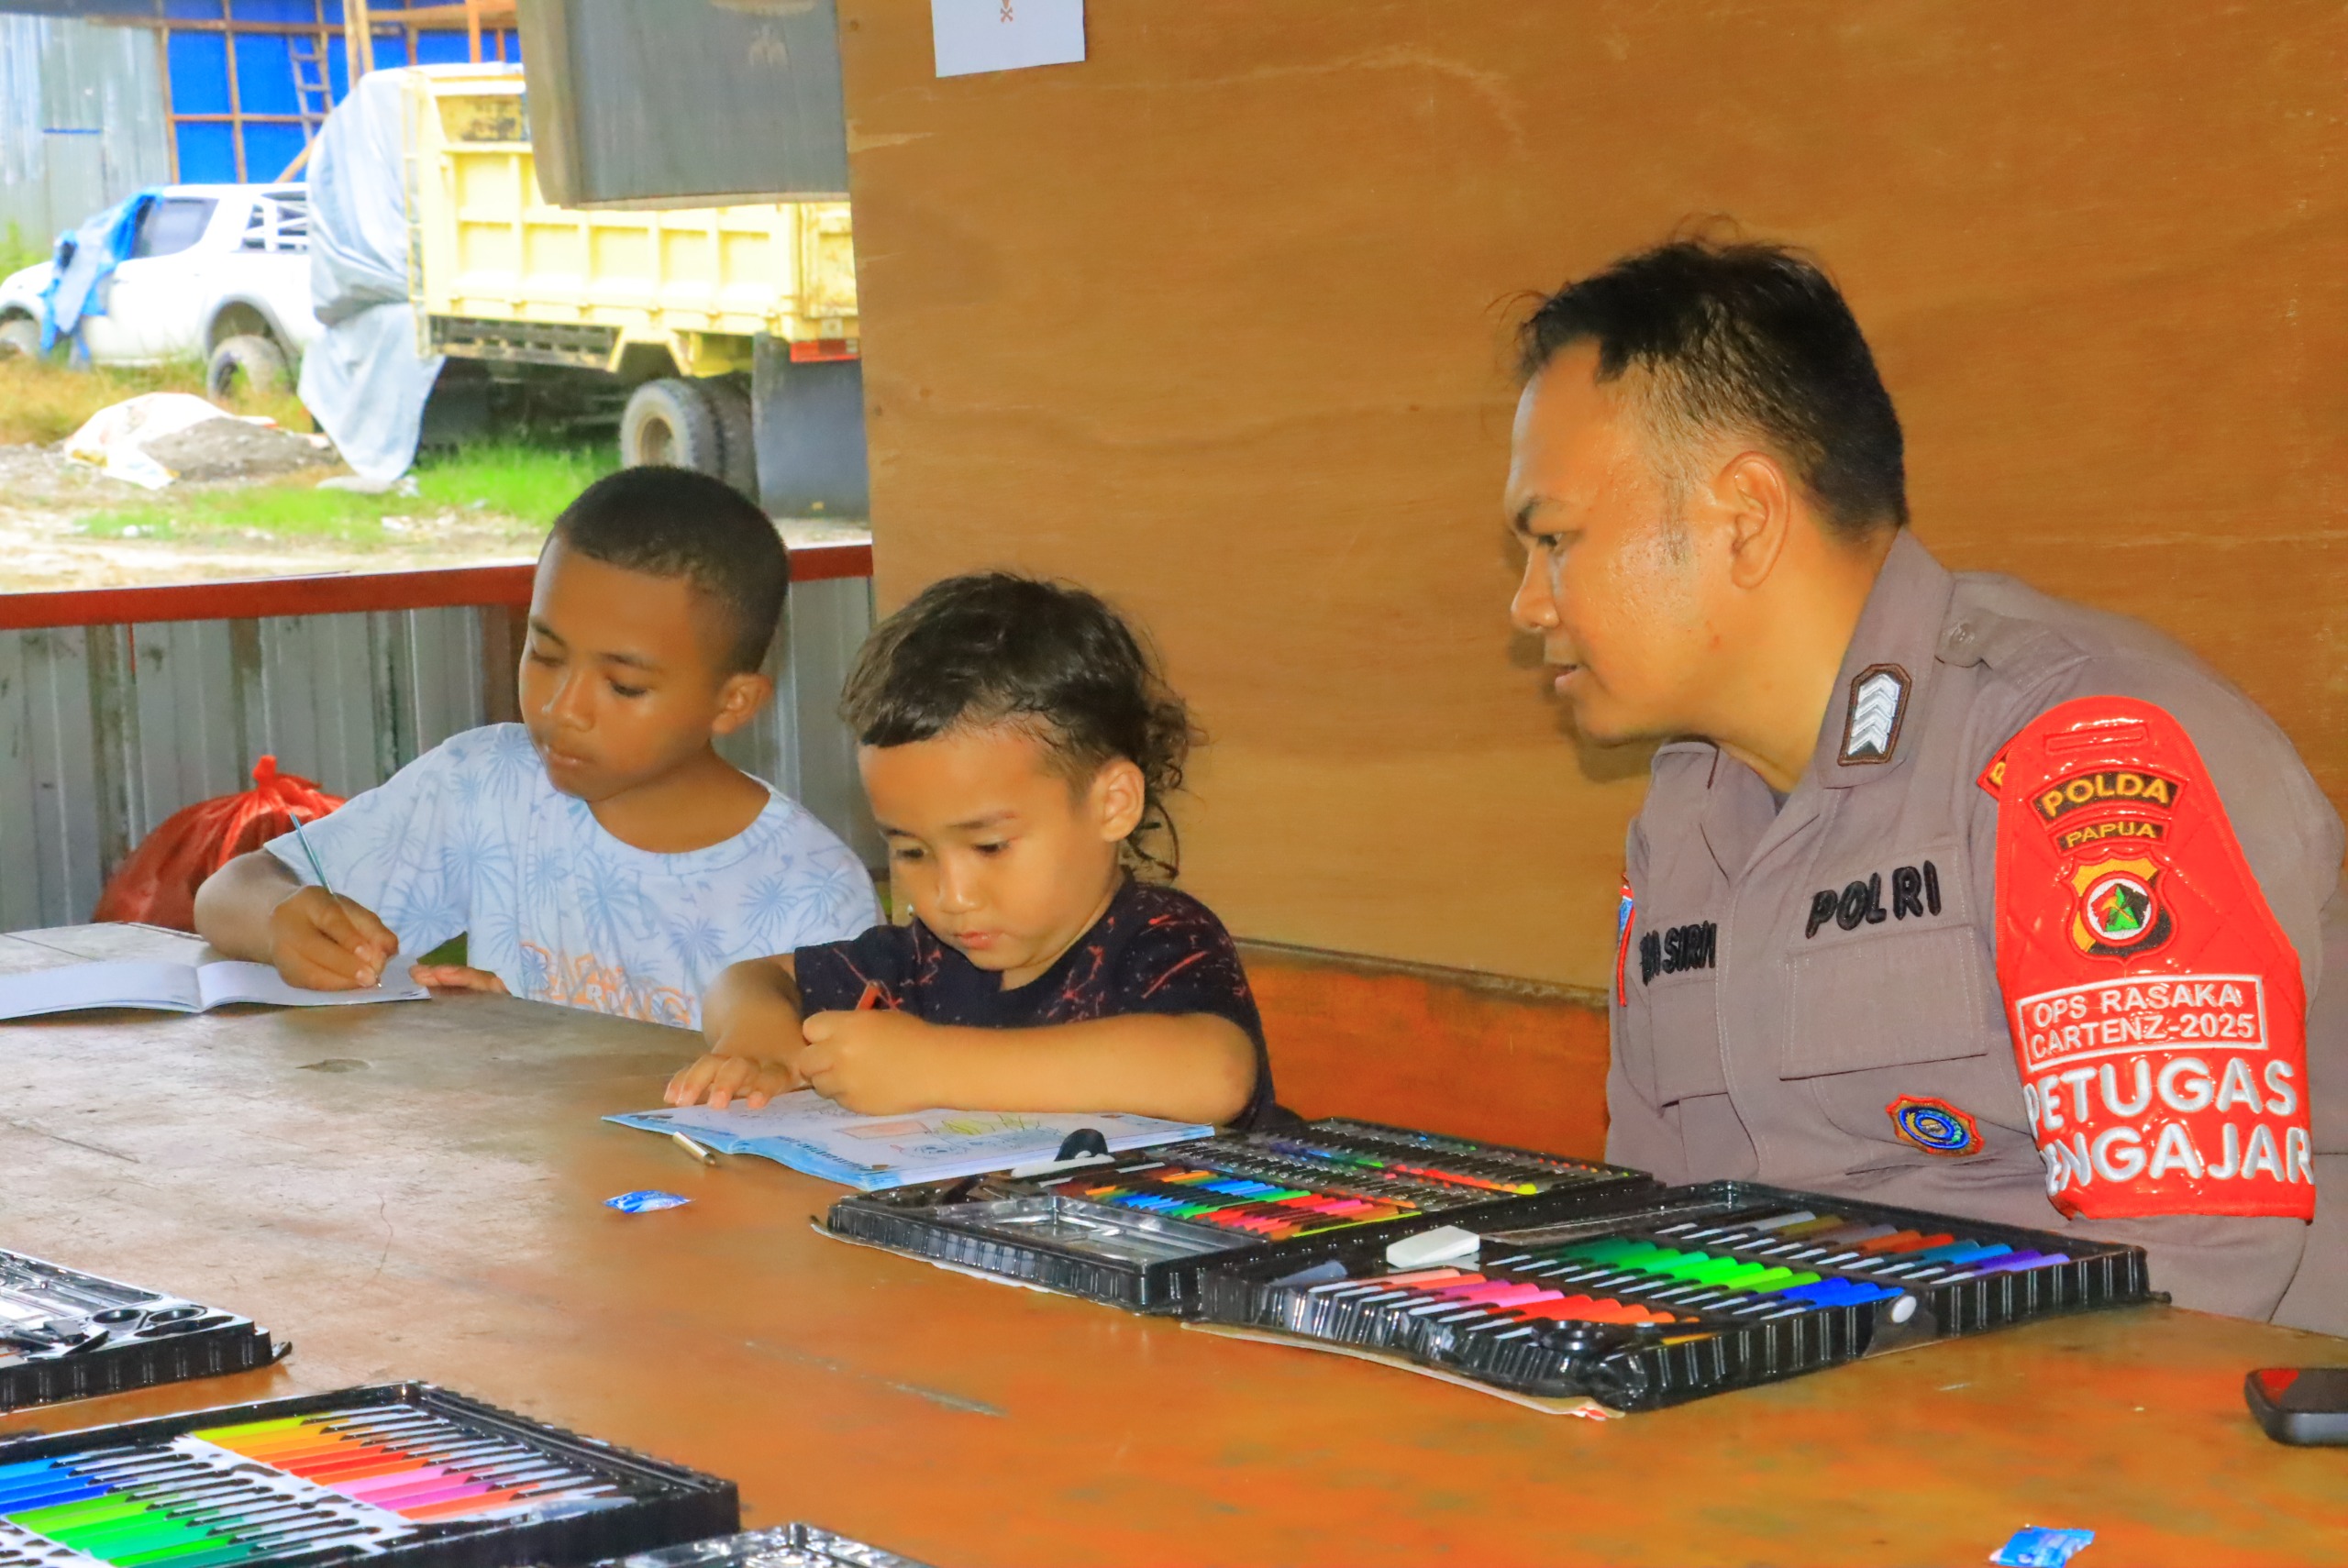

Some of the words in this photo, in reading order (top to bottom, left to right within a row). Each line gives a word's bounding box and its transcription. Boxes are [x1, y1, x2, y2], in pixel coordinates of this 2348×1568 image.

[2042, 773, 2169, 817] POLDA
[2066, 821, 2156, 848] PAPUA
[1805, 860, 1941, 939] POLRI
[2033, 995, 2087, 1028] OPS
[2100, 983, 2243, 1014] RASAKA
[2030, 1012, 2254, 1058] CARTENZ-2025
[2023, 1057, 2296, 1140] PETUGAS
[2039, 1123, 2315, 1196] ENGAJAR
